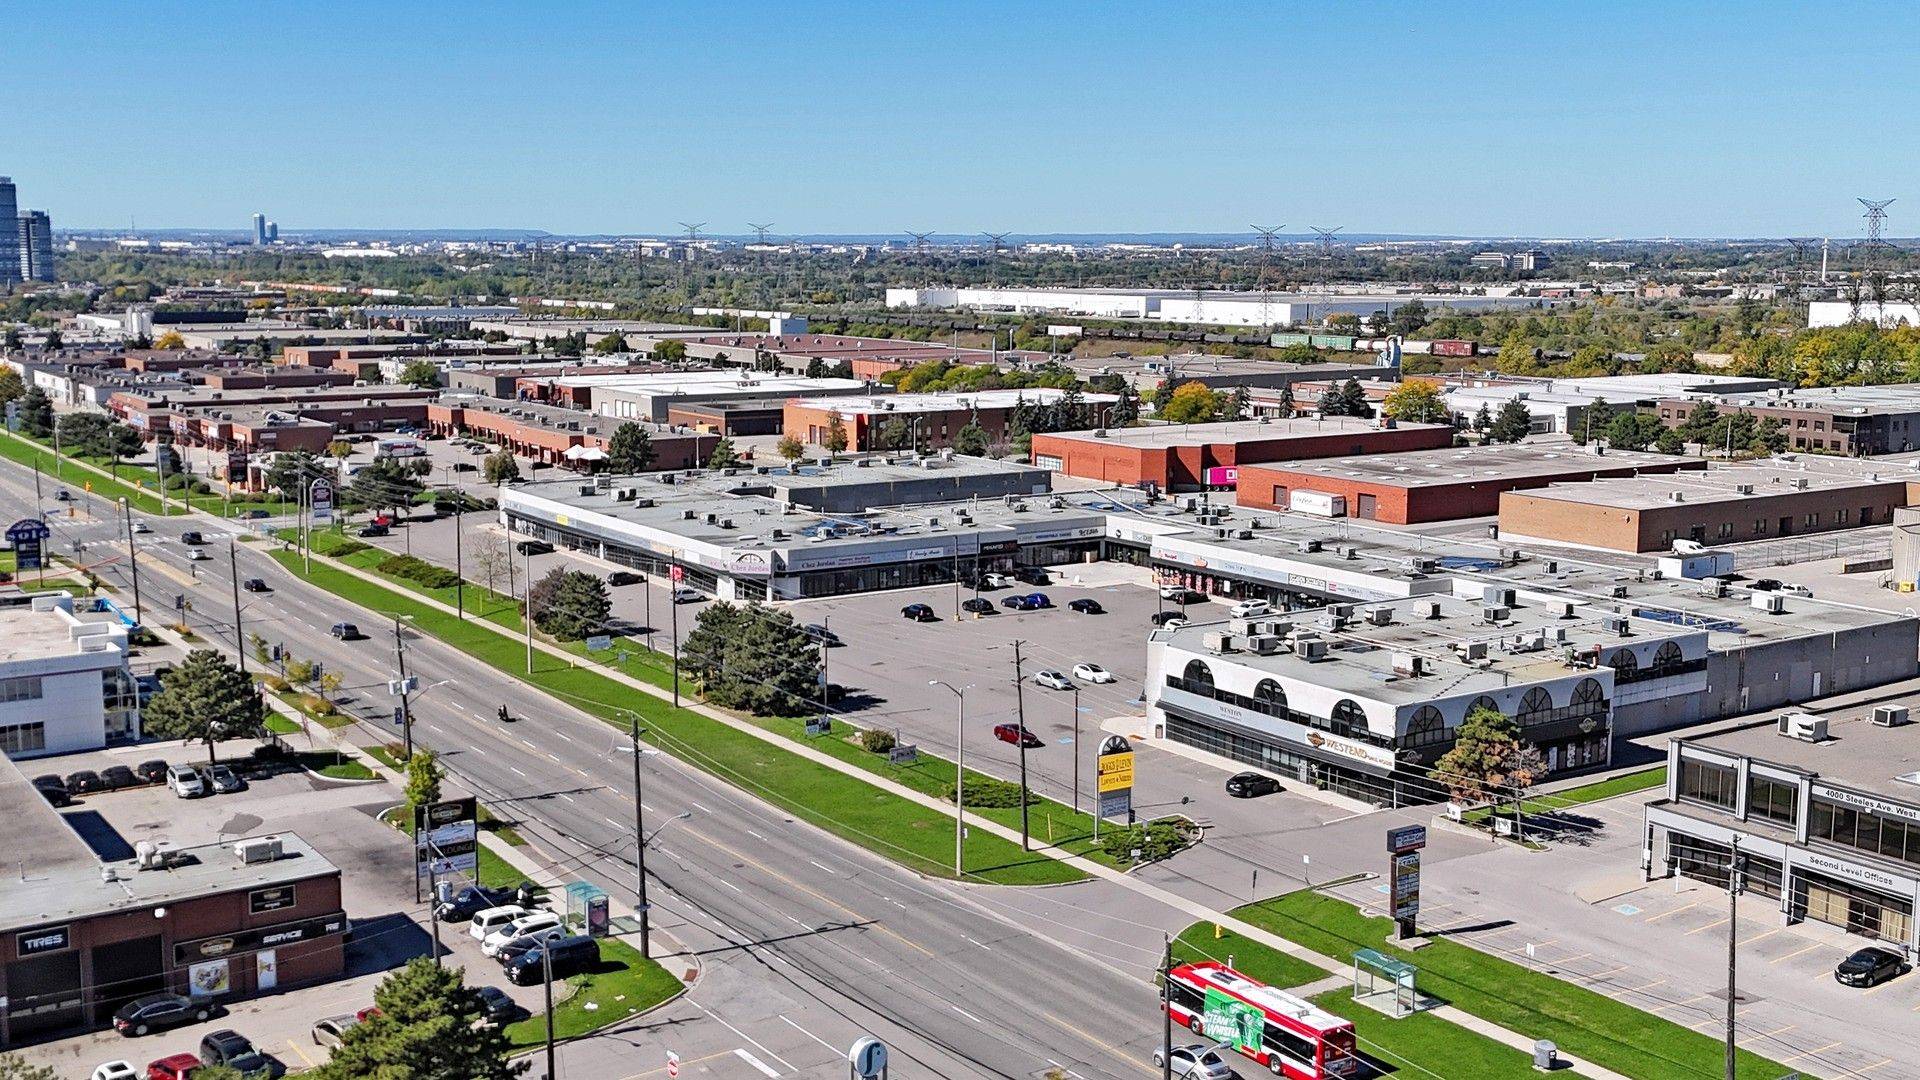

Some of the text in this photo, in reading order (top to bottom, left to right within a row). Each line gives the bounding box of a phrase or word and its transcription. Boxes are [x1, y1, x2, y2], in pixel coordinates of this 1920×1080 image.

[1326, 739, 1367, 759] WESTEND
[1825, 790, 1917, 819] 4000 Steeles Ave. West
[1809, 856, 1893, 886] Second Level Offices
[24, 934, 64, 950] TIRES
[263, 930, 302, 944] SERVICE
